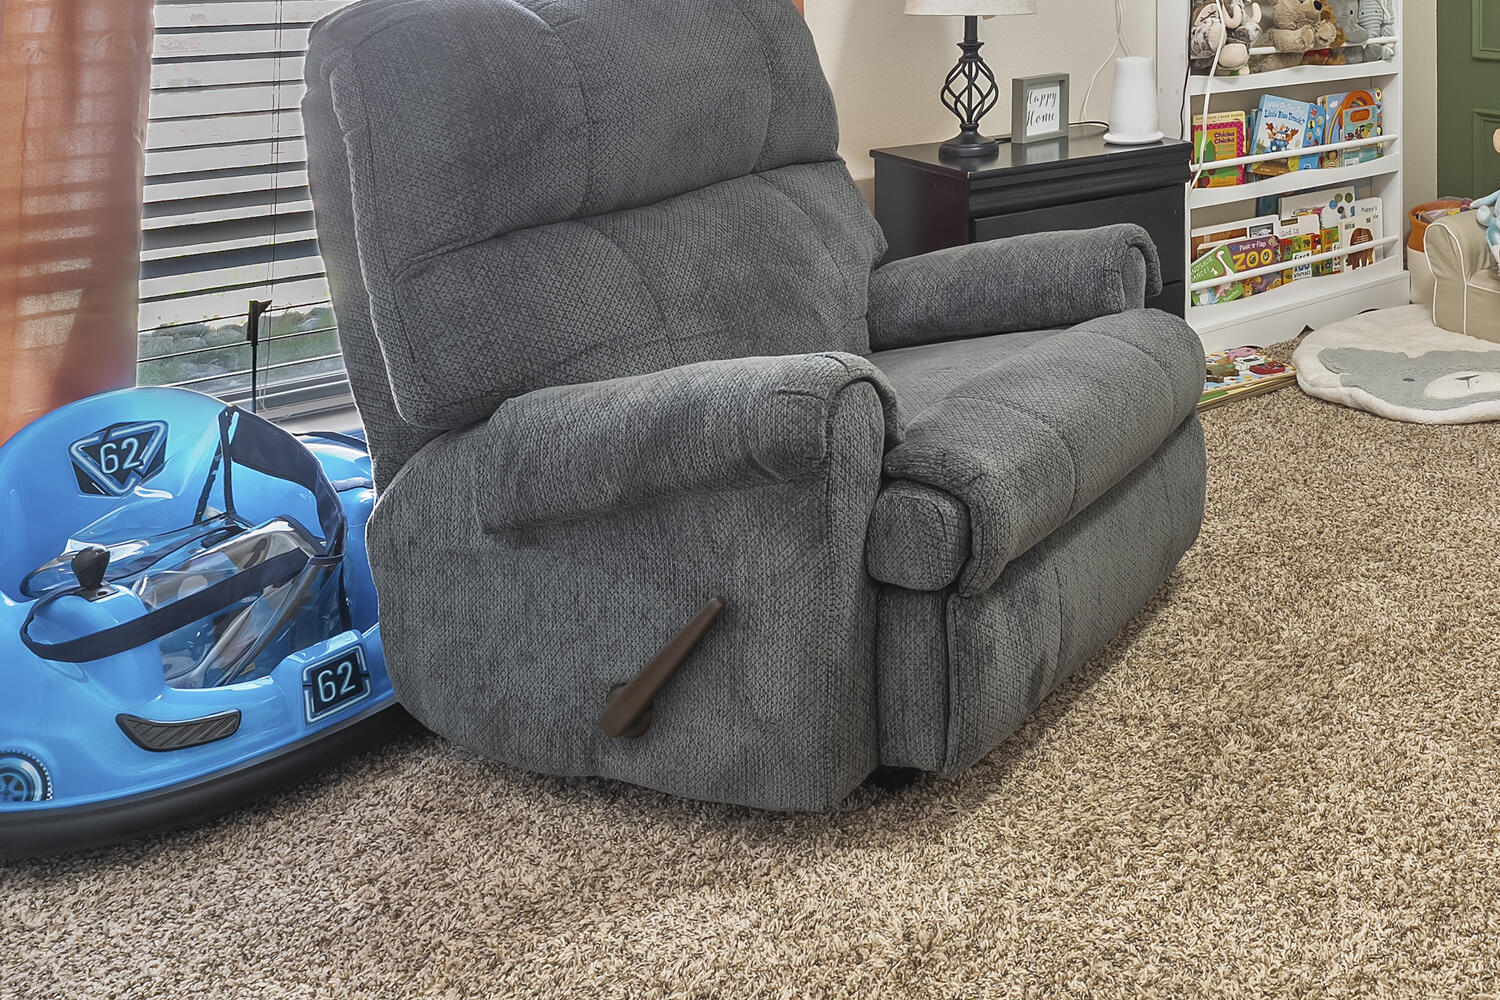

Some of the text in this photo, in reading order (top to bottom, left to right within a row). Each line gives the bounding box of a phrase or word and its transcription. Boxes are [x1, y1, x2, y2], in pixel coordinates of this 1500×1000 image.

[1027, 90, 1057, 108] Happy
[1213, 131, 1235, 139] Chicka
[1213, 137, 1235, 145] Chicka
[1232, 248, 1273, 271] ZOO
[100, 437, 141, 474] 62
[317, 661, 356, 702] 62
